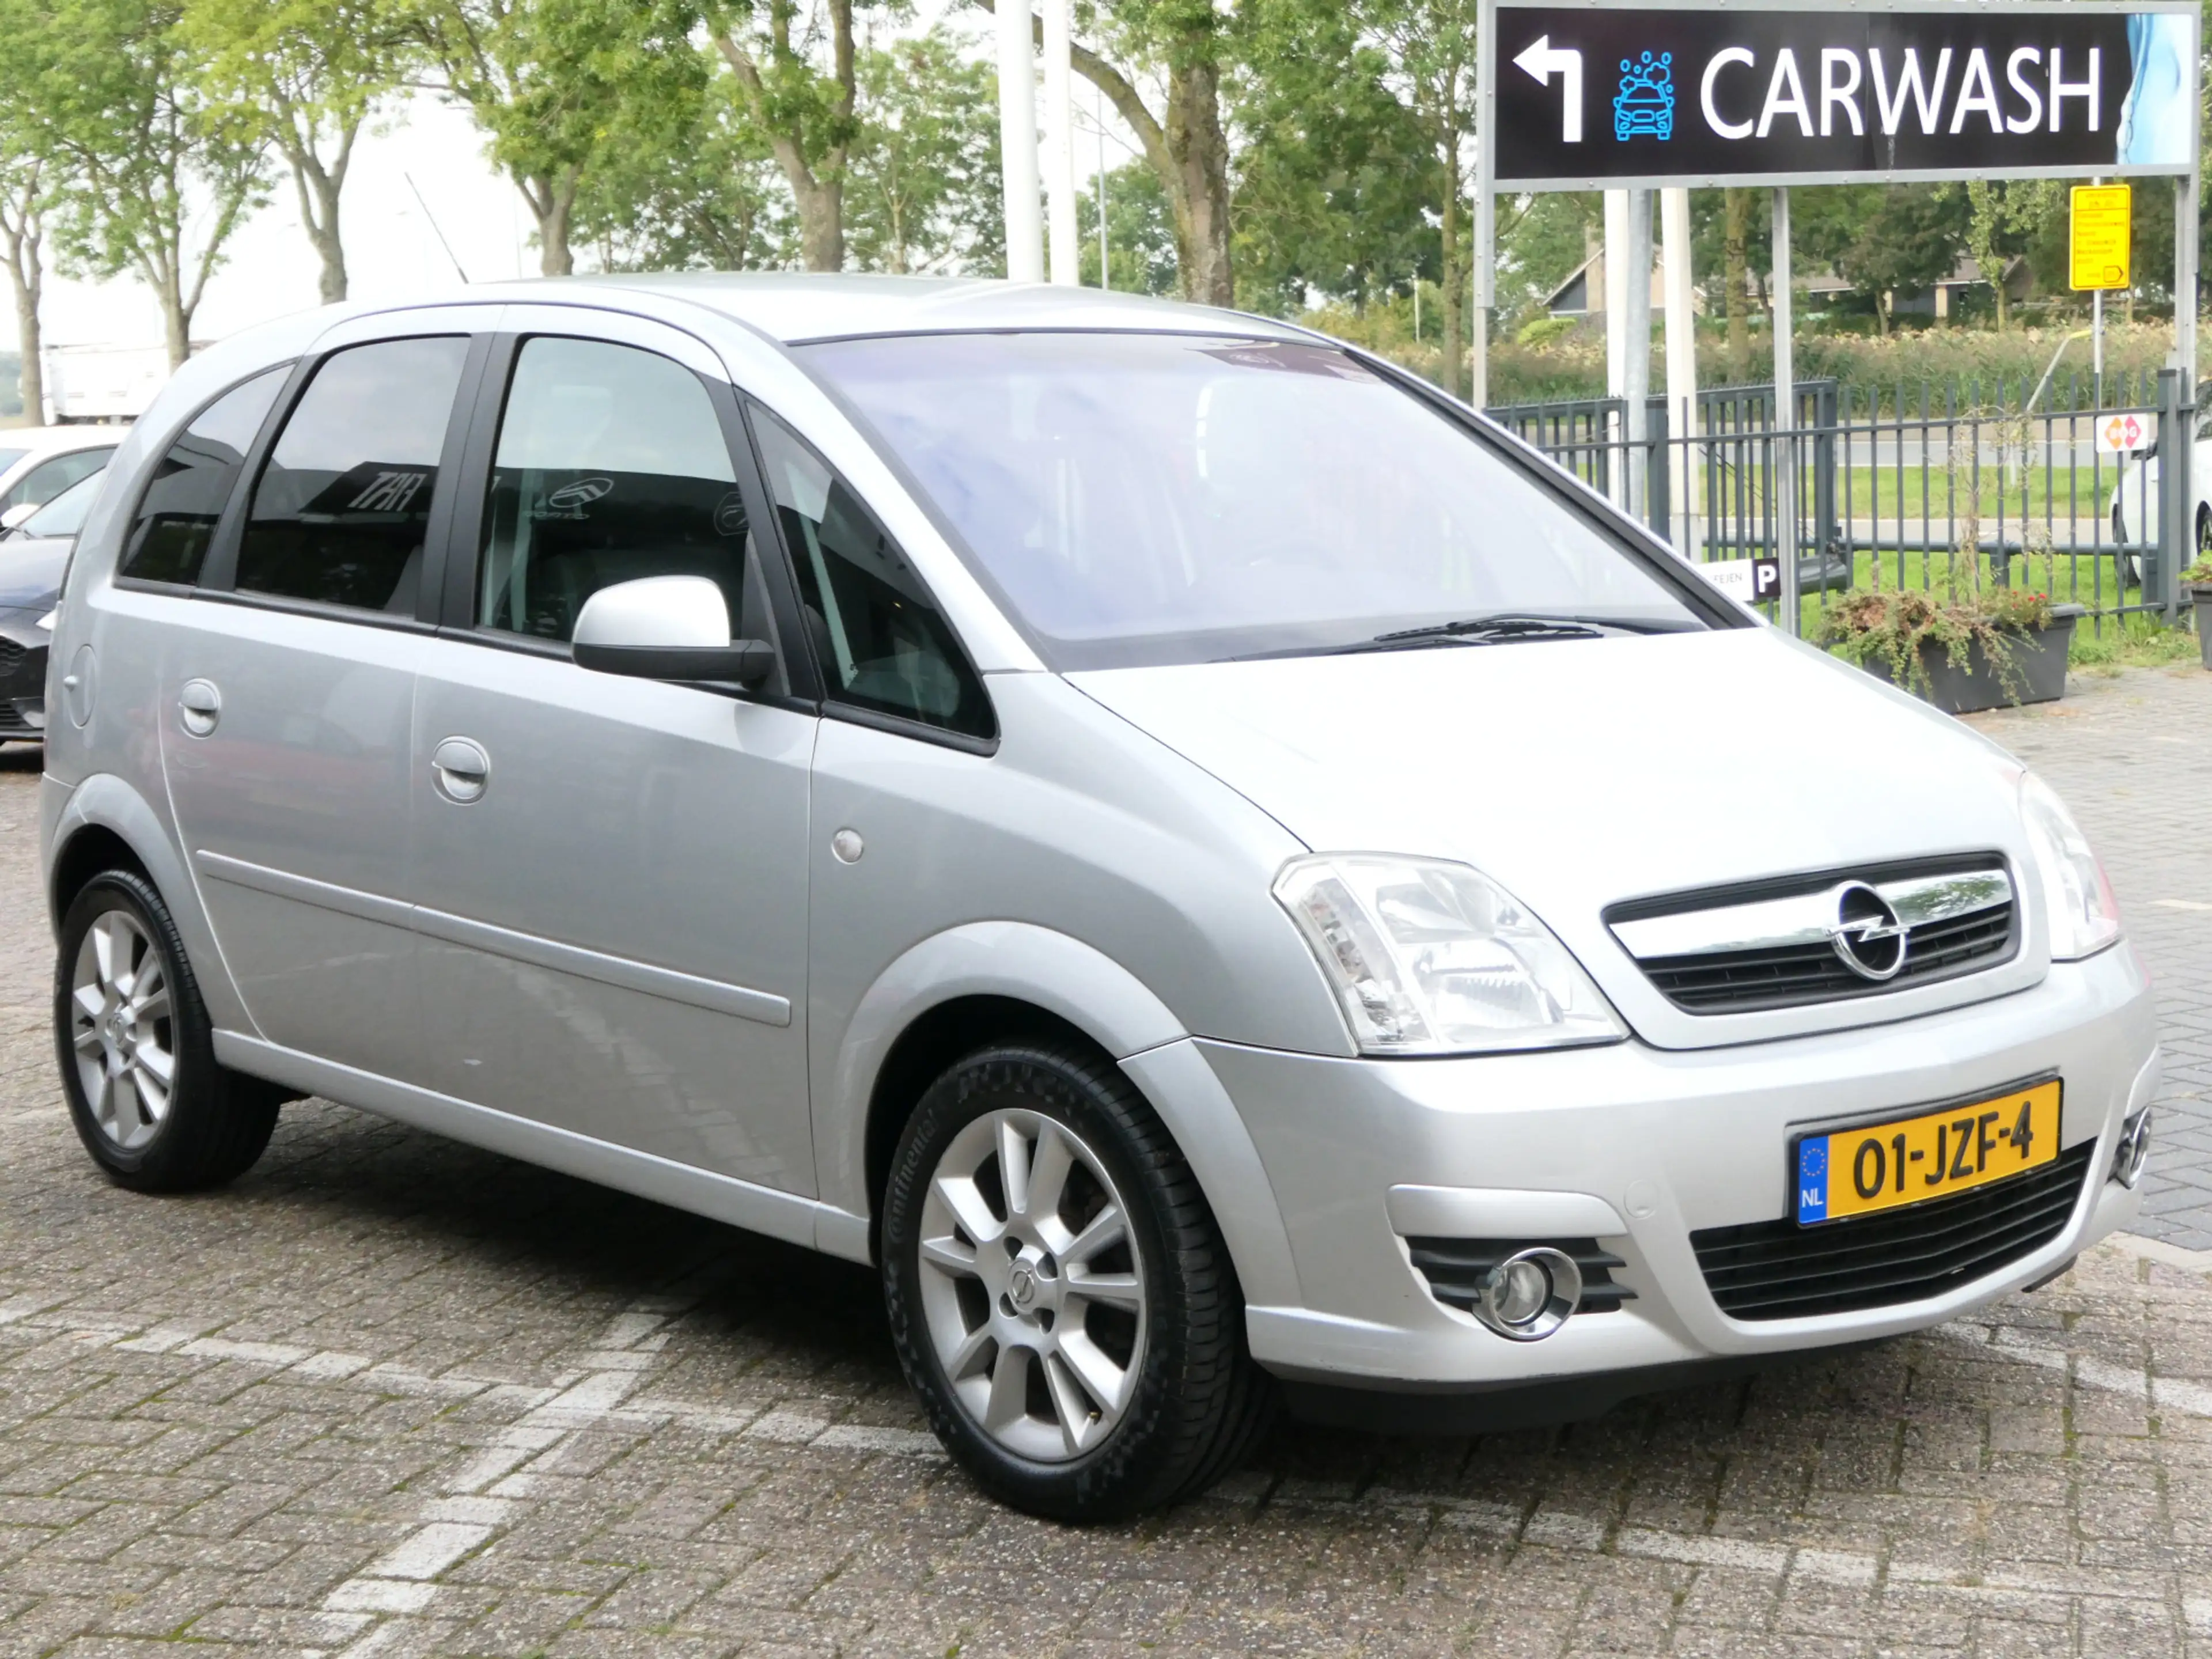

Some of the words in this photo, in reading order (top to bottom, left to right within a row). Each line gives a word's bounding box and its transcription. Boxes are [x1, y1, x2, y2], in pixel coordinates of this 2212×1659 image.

[1700, 46, 2100, 140] CARWASH
[1758, 565, 1777, 593] P
[1853, 1101, 2033, 1199] 01-JZF-4
[1801, 1188, 1823, 1208] NL
